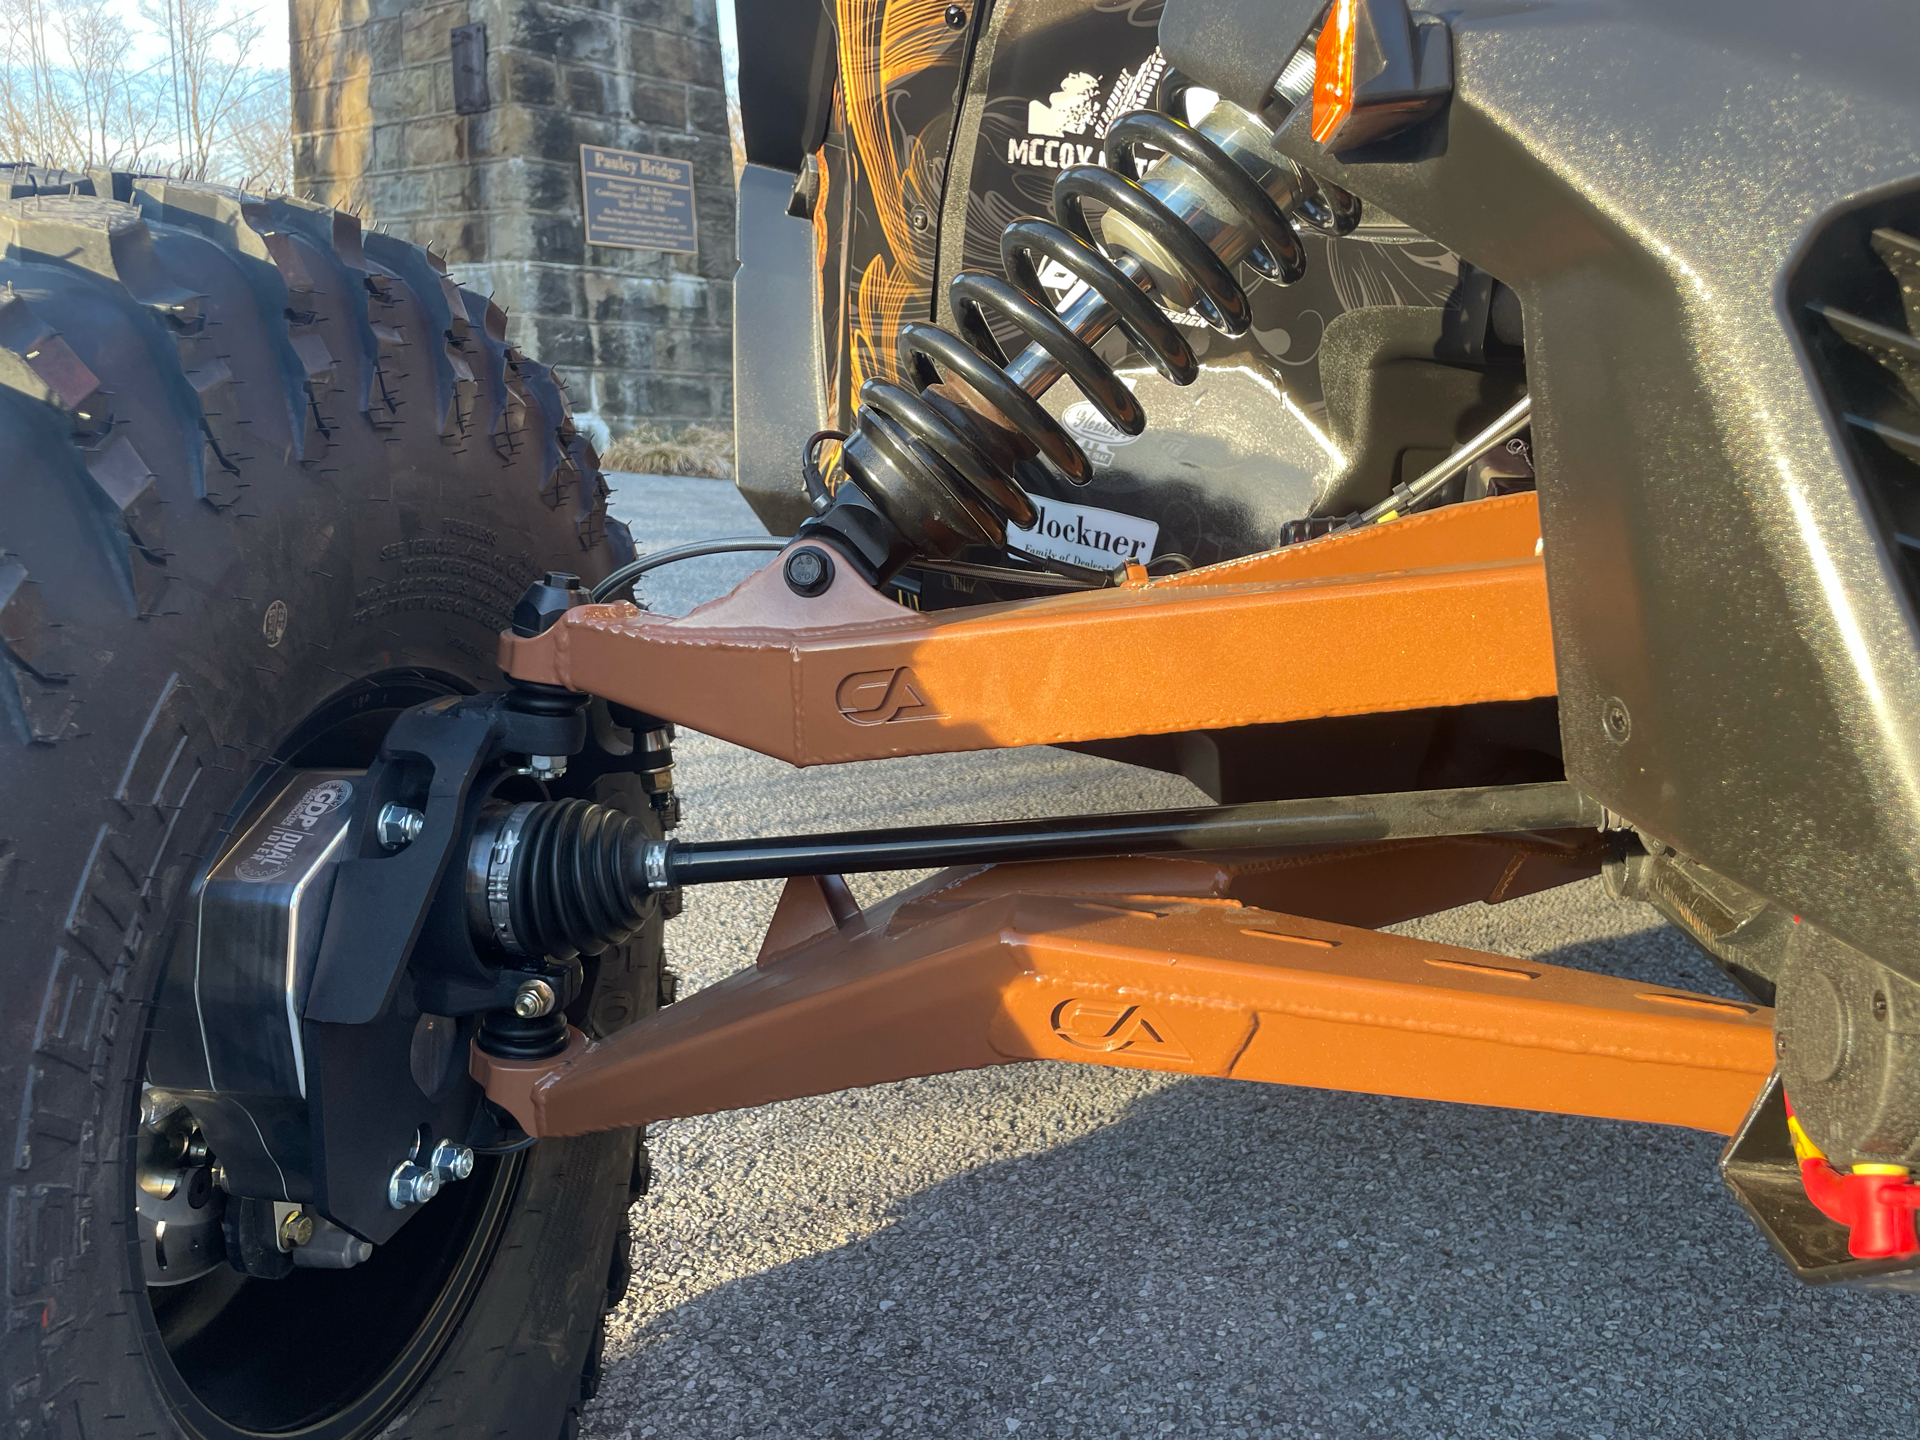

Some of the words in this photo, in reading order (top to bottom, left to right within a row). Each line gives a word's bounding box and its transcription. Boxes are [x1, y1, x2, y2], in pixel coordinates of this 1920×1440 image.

[594, 152, 638, 176] Pauley
[641, 159, 682, 182] Bridge
[1007, 138, 1093, 170] MCCOY
[1036, 506, 1146, 558] lockner
[299, 789, 338, 828] GDP
[250, 829, 283, 861] IDLER
[260, 832, 303, 866] DUAL
